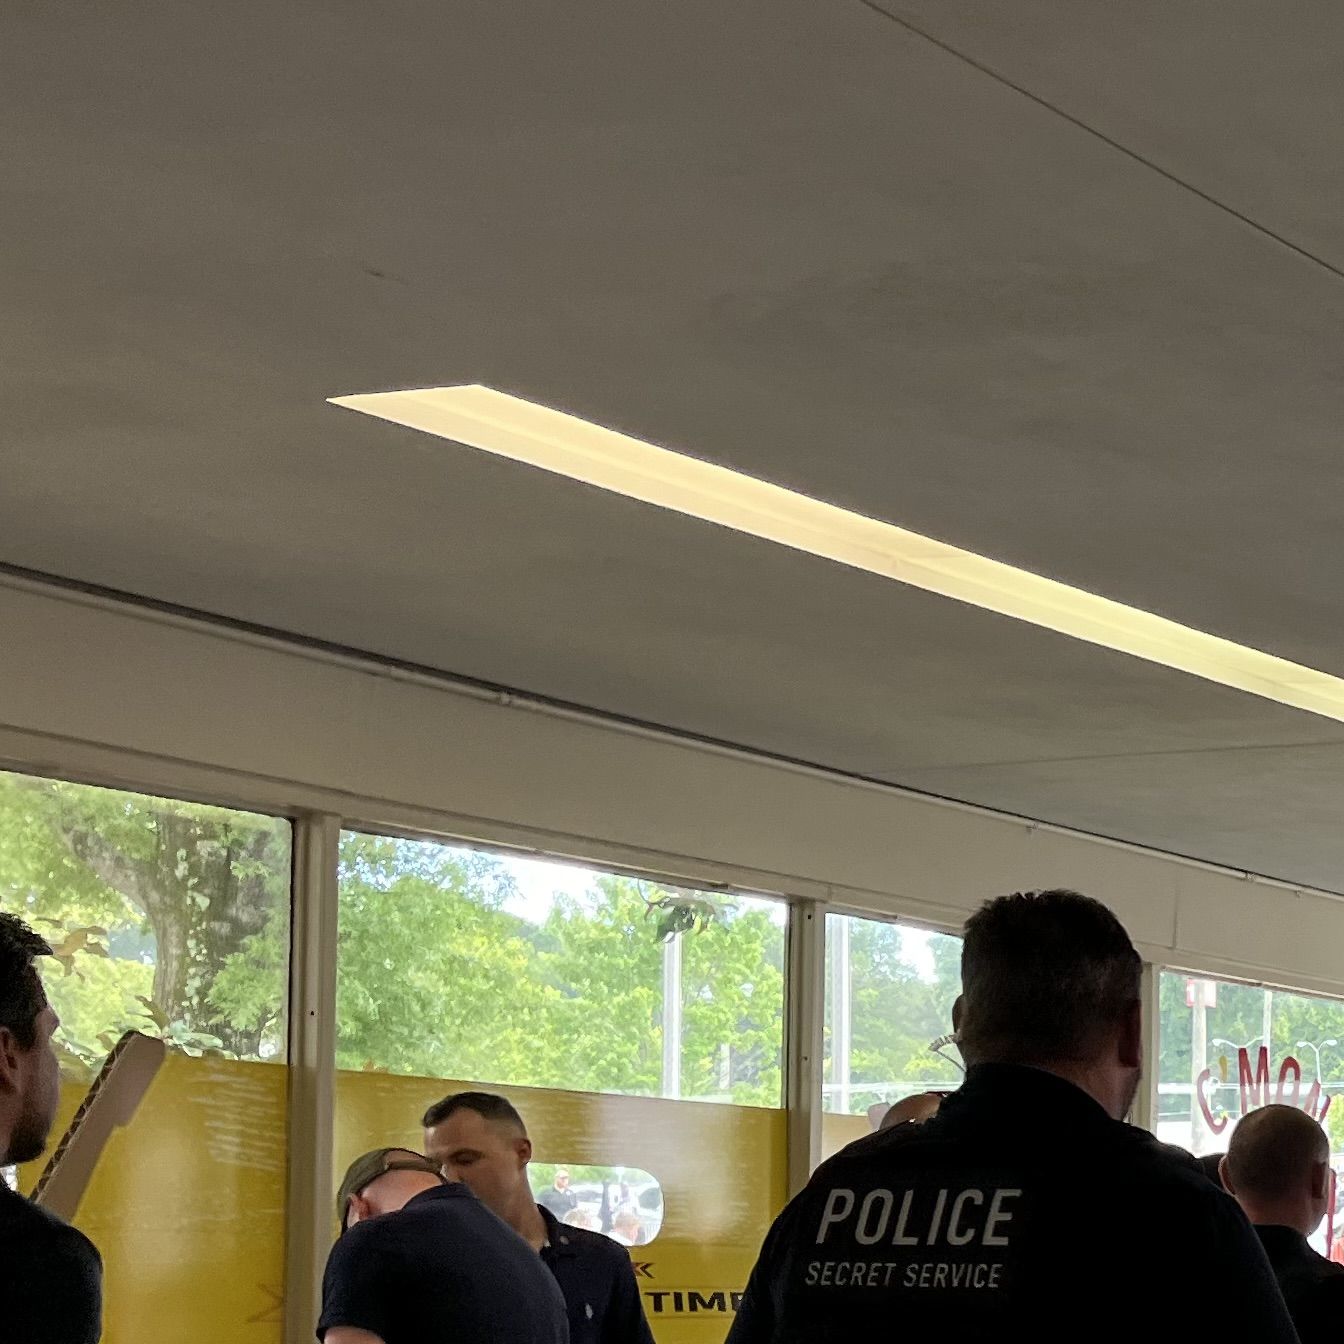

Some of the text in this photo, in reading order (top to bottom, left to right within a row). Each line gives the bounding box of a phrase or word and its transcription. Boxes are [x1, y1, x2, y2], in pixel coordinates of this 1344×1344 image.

[816, 1188, 1023, 1246] POLICE
[804, 1261, 1004, 1289] SECRET SERVICE
